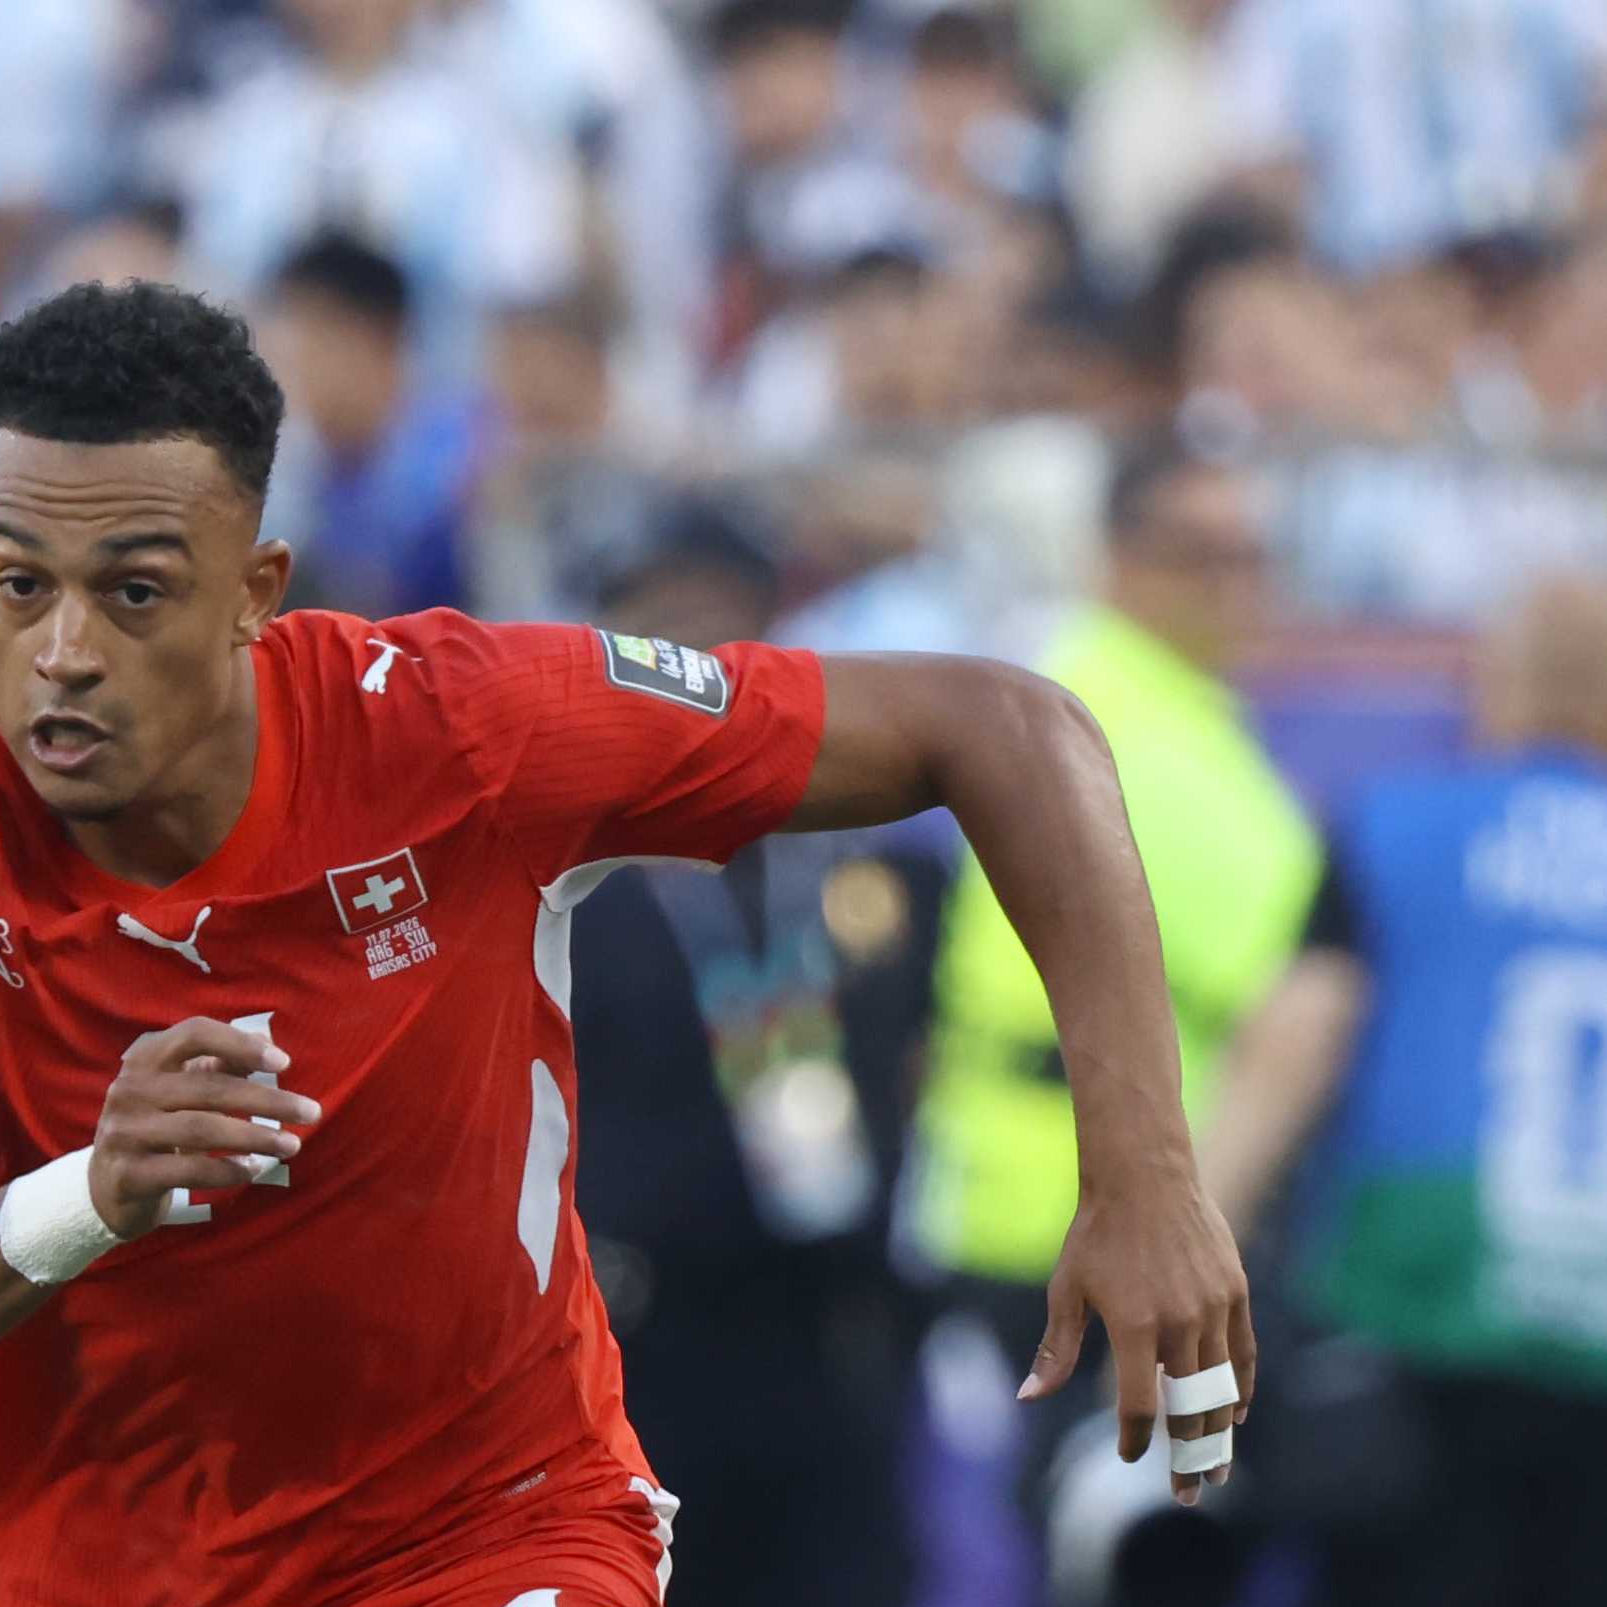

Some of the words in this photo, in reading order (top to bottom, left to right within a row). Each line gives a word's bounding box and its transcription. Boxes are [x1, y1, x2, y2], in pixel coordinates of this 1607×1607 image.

[365, 916, 420, 947] 11.07.2026
[365, 942, 395, 965] ARG
[404, 926, 430, 949] SUI
[367, 953, 412, 981] KANSAS
[411, 942, 438, 964] CITY
